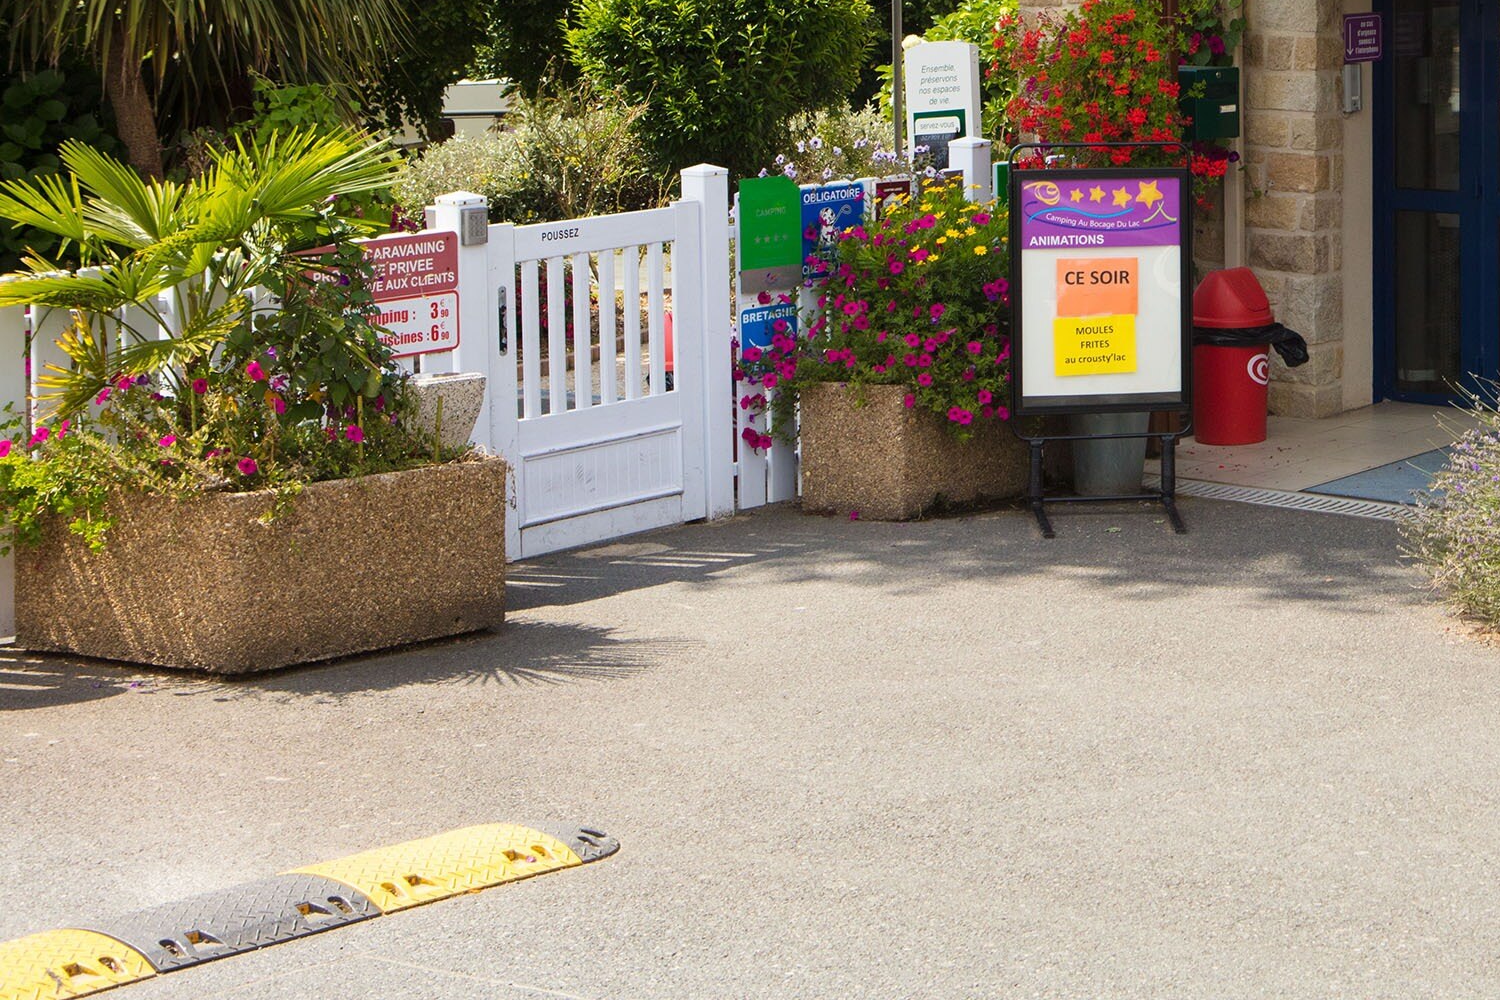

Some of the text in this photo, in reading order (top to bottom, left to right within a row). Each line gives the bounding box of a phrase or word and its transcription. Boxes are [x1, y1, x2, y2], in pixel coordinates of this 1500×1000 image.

[920, 74, 958, 85] préservons
[932, 85, 960, 95] espaces
[929, 97, 938, 105] de
[803, 187, 861, 204] OBLIGATOIRE
[756, 206, 787, 218] CAMPING
[1046, 213, 1077, 227] Camping
[1078, 219, 1087, 227] Au
[1089, 220, 1115, 229] Bocage
[1117, 220, 1126, 228] Du
[541, 228, 579, 241] POUSSEZ
[1029, 234, 1105, 247] ANIMATIONS
[363, 240, 445, 261] CARAVANING
[389, 259, 434, 276] PRIVEE
[385, 276, 409, 292] AUX
[410, 271, 456, 288] CLIENTS
[1064, 270, 1130, 285] CE SOIR
[430, 302, 439, 320] 3
[742, 305, 796, 324] BRETAGNE
[1075, 326, 1114, 335] MOULES
[1080, 340, 1110, 349] FRITES
[1065, 356, 1076, 364] au
